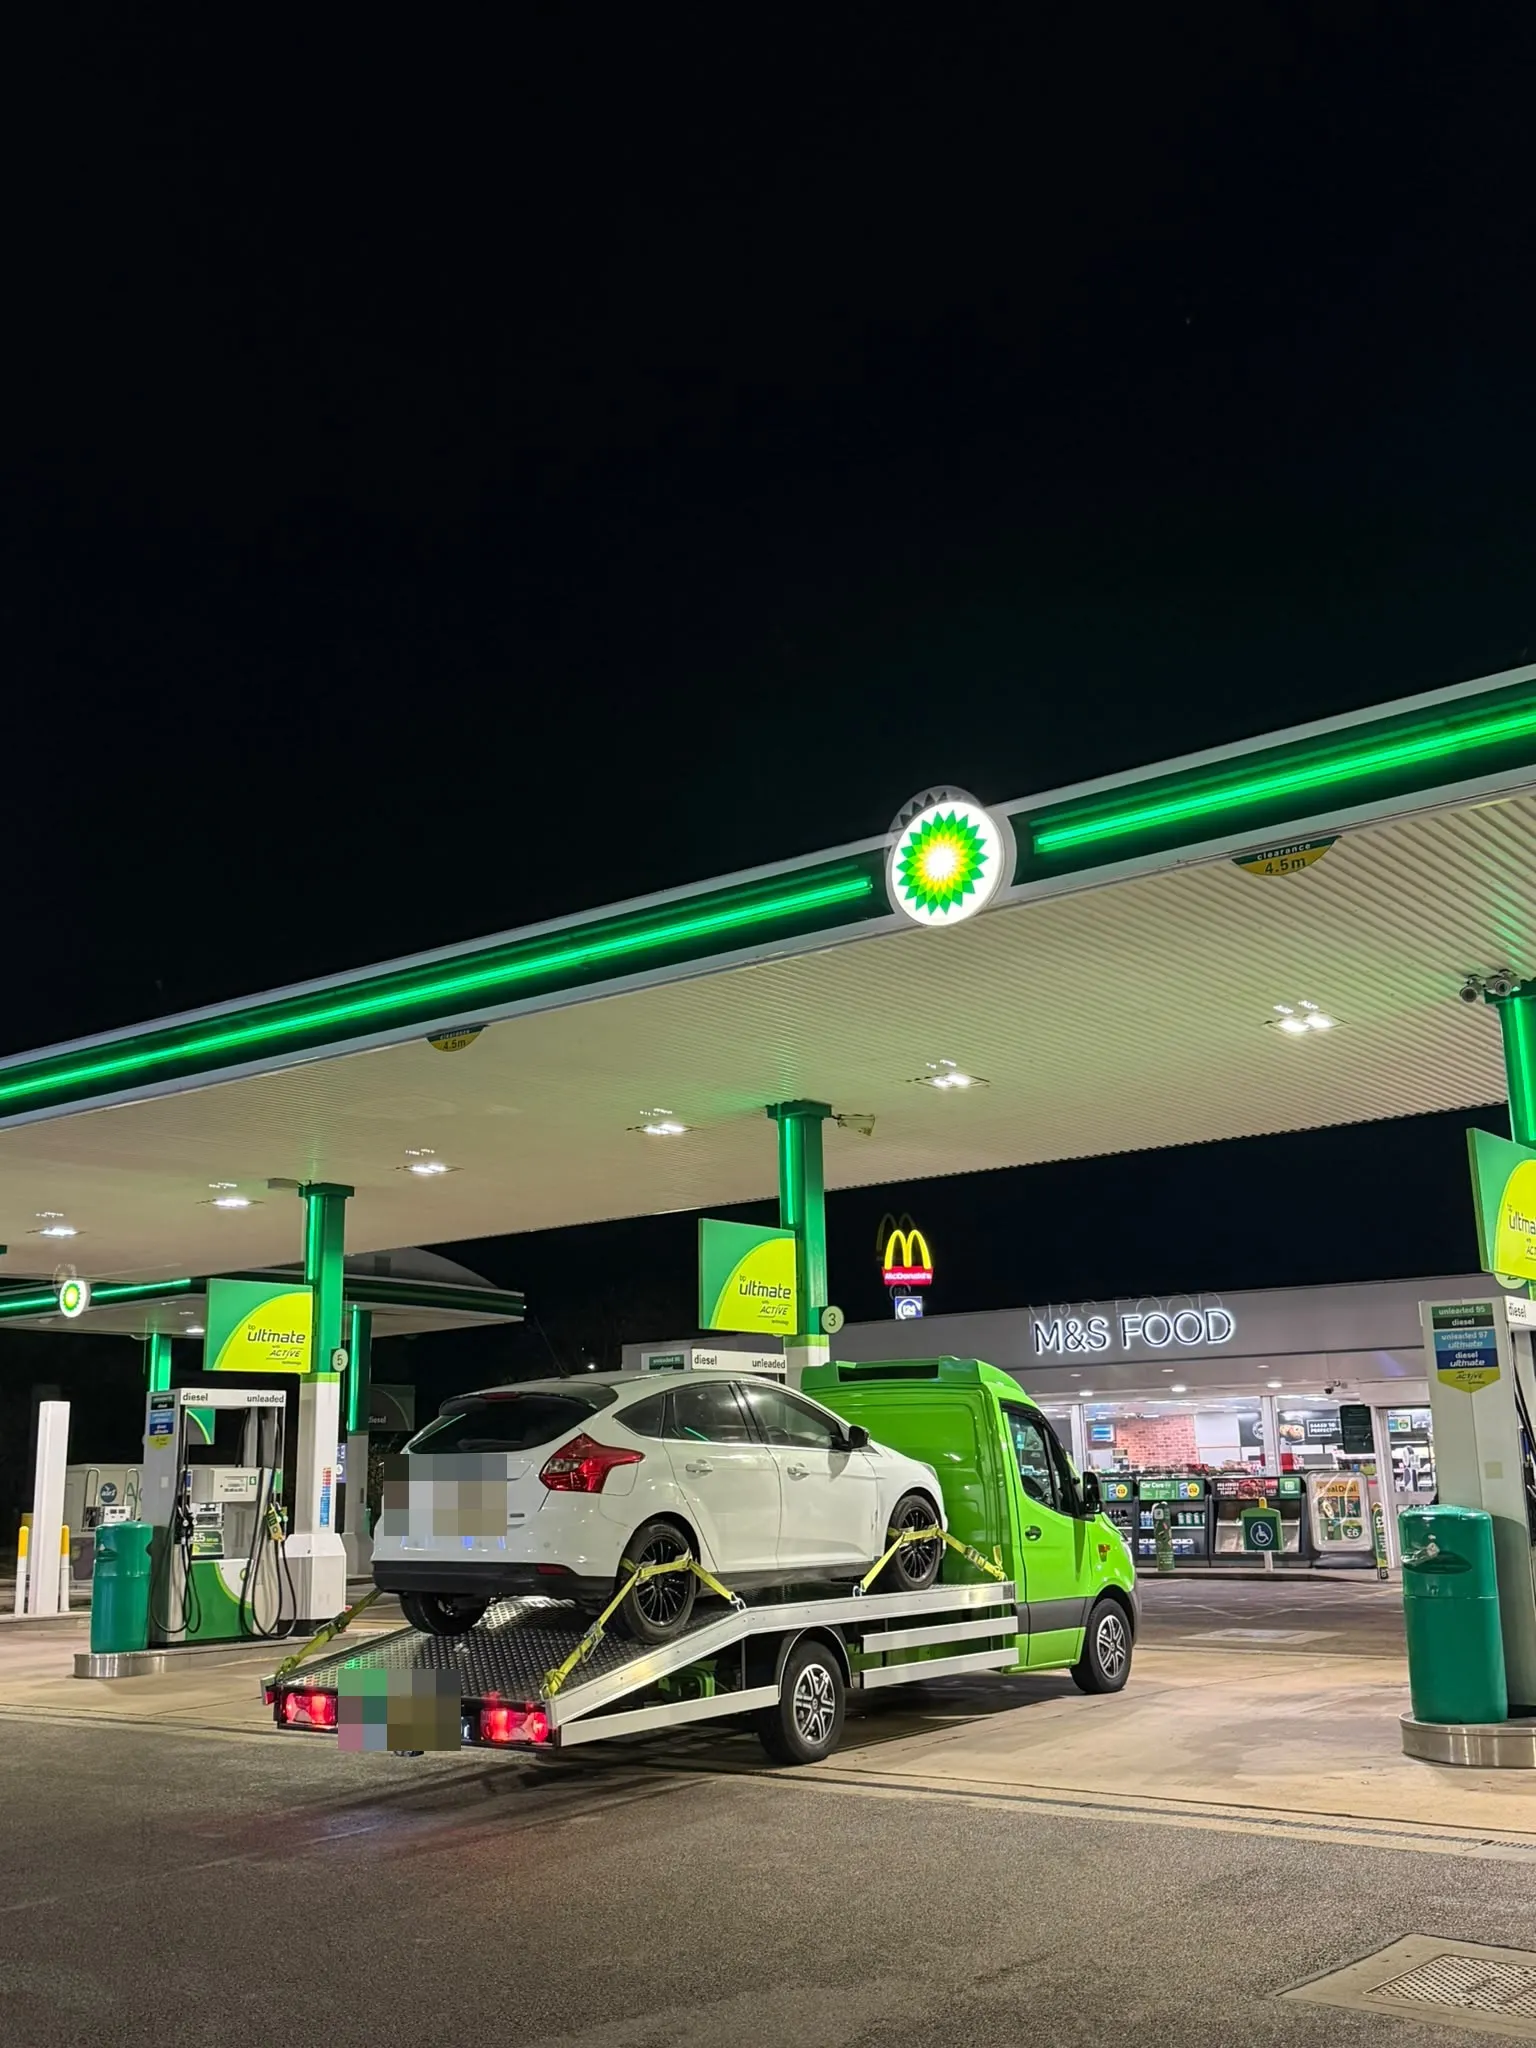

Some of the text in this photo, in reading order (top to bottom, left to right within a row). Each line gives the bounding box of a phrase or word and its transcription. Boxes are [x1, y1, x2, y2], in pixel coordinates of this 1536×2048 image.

[1257, 843, 1311, 861] clearance
[1265, 857, 1306, 874] 4.5m
[1508, 1211, 1536, 1236] ultima
[739, 1280, 792, 1300] ultimate
[759, 1305, 788, 1316] ACTIVE
[1438, 1307, 1474, 1316] unleaded
[828, 1313, 837, 1327] 3
[1451, 1318, 1475, 1327] diesel
[247, 1328, 306, 1344] ultimate
[1033, 1308, 1234, 1355] M&S FOOD
[1441, 1332, 1477, 1341] unleaded
[1447, 1340, 1483, 1350] ultimate
[269, 1349, 301, 1358] ACTIVE
[1454, 1351, 1479, 1359] diesel
[336, 1354, 344, 1367] 5
[694, 1355, 718, 1366] diesel
[752, 1358, 786, 1369] unleaded
[1449, 1359, 1486, 1368] ultimate
[182, 1393, 209, 1402] diesel
[246, 1395, 285, 1403] unleaded
[1346, 1528, 1360, 1537] £6
